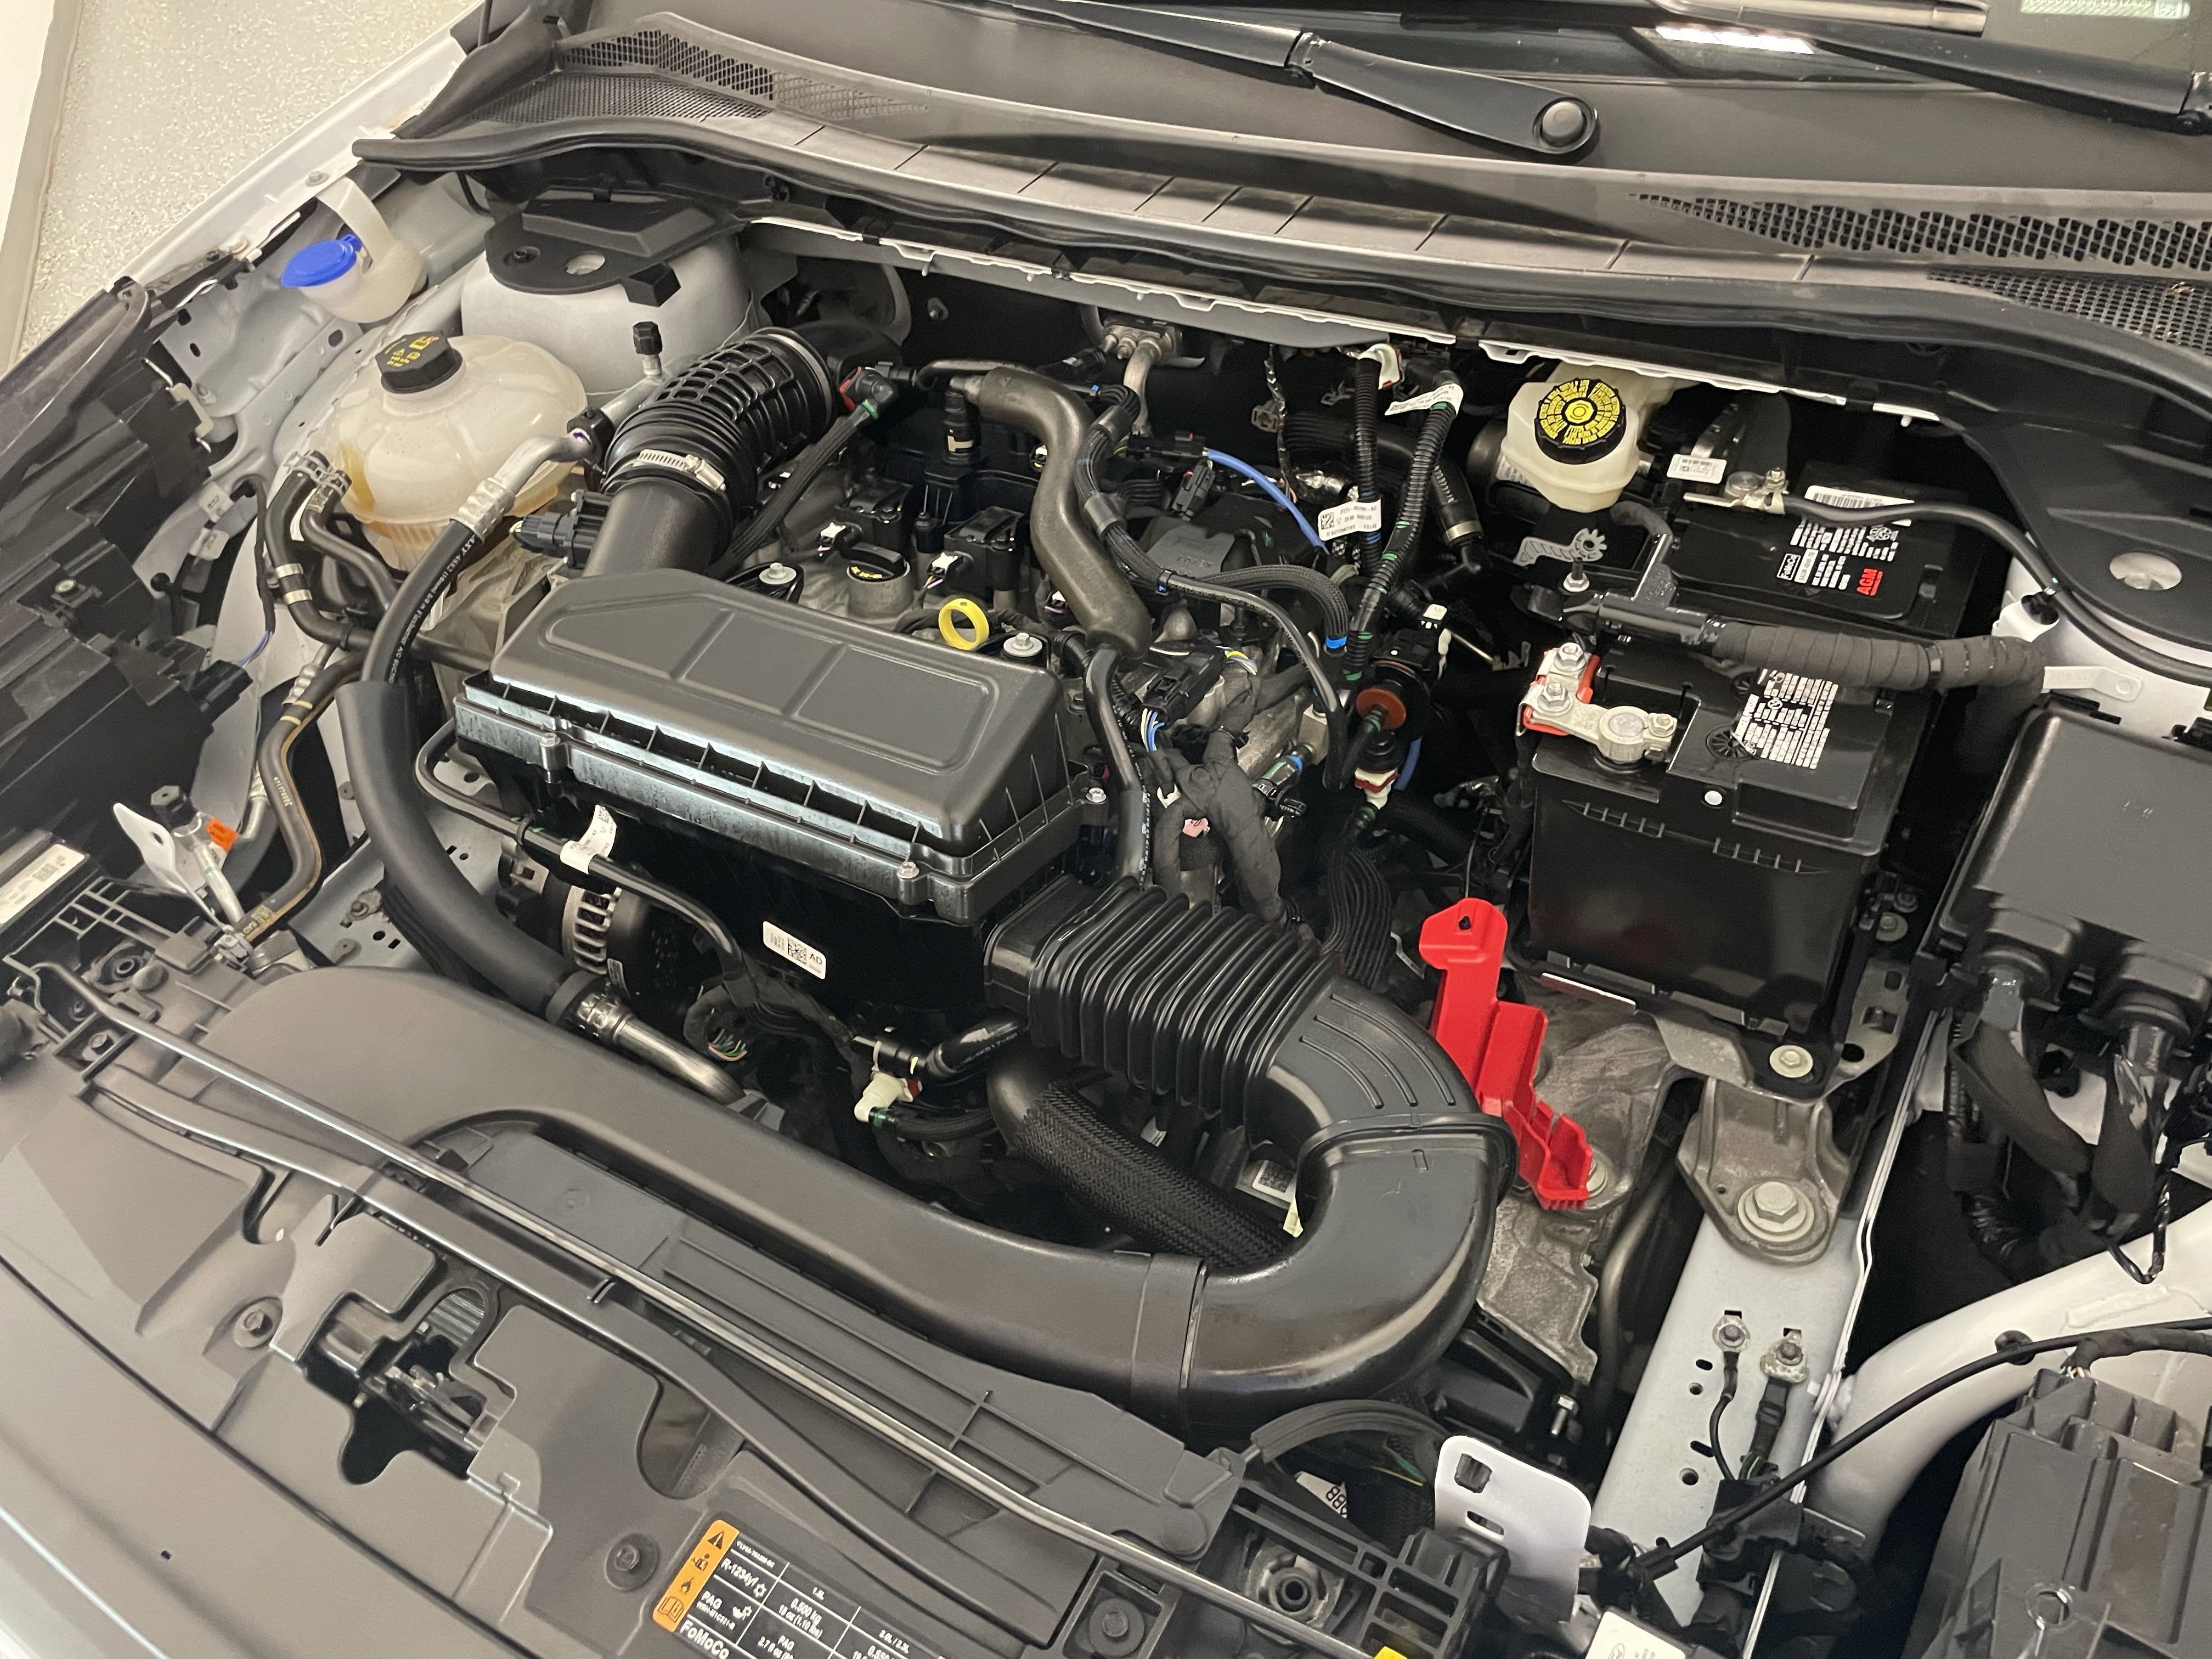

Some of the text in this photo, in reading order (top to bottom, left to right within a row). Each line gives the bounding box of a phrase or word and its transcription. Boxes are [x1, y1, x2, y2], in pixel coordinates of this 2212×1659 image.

[1856, 567, 1878, 596] AGM
[810, 953, 823, 966] AD
[720, 1558, 759, 1587] R-1234yf
[701, 1590, 723, 1610] PAG
[791, 1598, 822, 1627] 0.500 kg
[680, 1619, 730, 1659] FoMoCo
[777, 1635, 795, 1651] PAG
